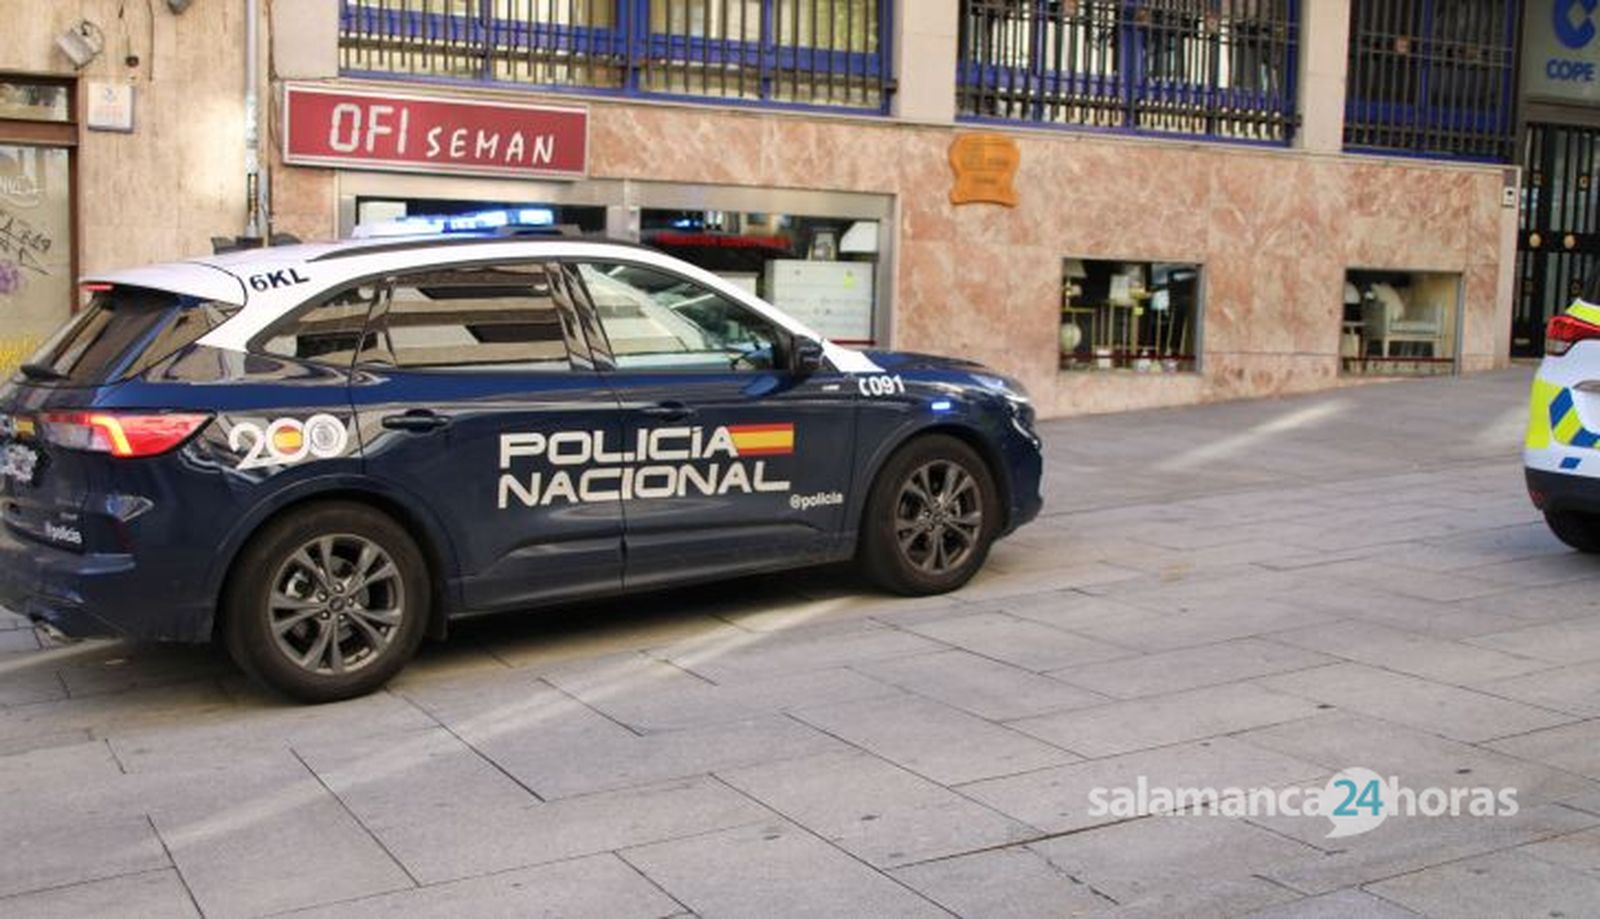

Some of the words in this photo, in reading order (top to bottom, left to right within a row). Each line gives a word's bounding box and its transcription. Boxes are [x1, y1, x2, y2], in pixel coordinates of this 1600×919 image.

[1546, 58, 1596, 82] COPE
[329, 103, 410, 153] OFI
[426, 126, 556, 164] SEMAN
[249, 268, 310, 291] 6KL
[228, 413, 348, 470] 200
[498, 461, 790, 509] NACIONAL
